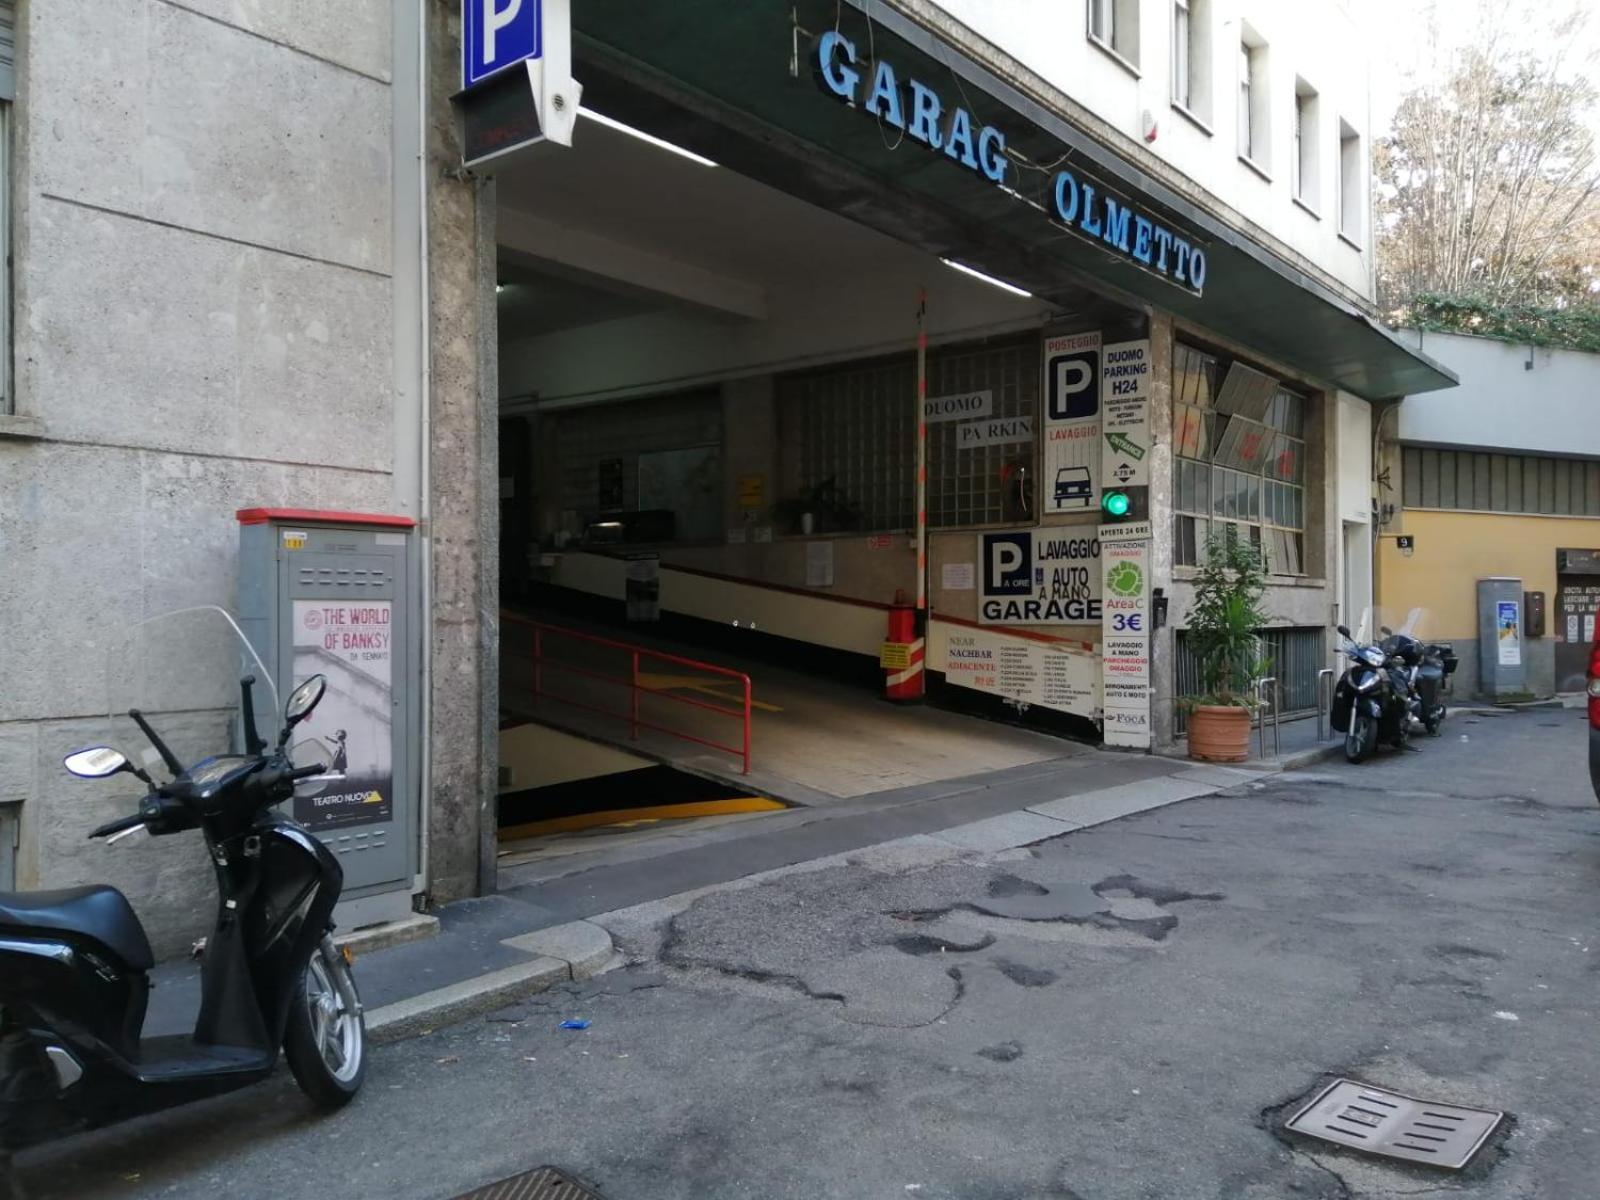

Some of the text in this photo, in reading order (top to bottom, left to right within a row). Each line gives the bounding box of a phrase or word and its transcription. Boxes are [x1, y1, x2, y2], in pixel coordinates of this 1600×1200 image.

[819, 31, 1206, 289] GARAG OLMETTO
[1048, 335, 1099, 352] POSTEGGIO
[1107, 349, 1144, 363] DUOMO
[1103, 363, 1147, 378] PARKING
[1057, 360, 1093, 413] P
[1112, 380, 1138, 395] H24
[924, 396, 983, 416] DUOMO
[1049, 425, 1097, 441] LAVAGGIO
[1038, 539, 1100, 560] LAVAGGIO
[1401, 538, 1408, 547] 9
[992, 541, 1023, 588] P
[1052, 567, 1089, 587] AUTO
[1039, 585, 1091, 601] A MANO
[323, 608, 390, 625] THE WORLD
[983, 600, 1103, 621] GARAGE
[1112, 613, 1143, 631] 3€
[324, 632, 390, 650] OF BANKSY
[949, 637, 976, 647] NEAR
[949, 649, 993, 659] NACHBAR
[948, 663, 996, 672] ADIACENTE
[312, 790, 374, 807] TEATRO NUOVO
